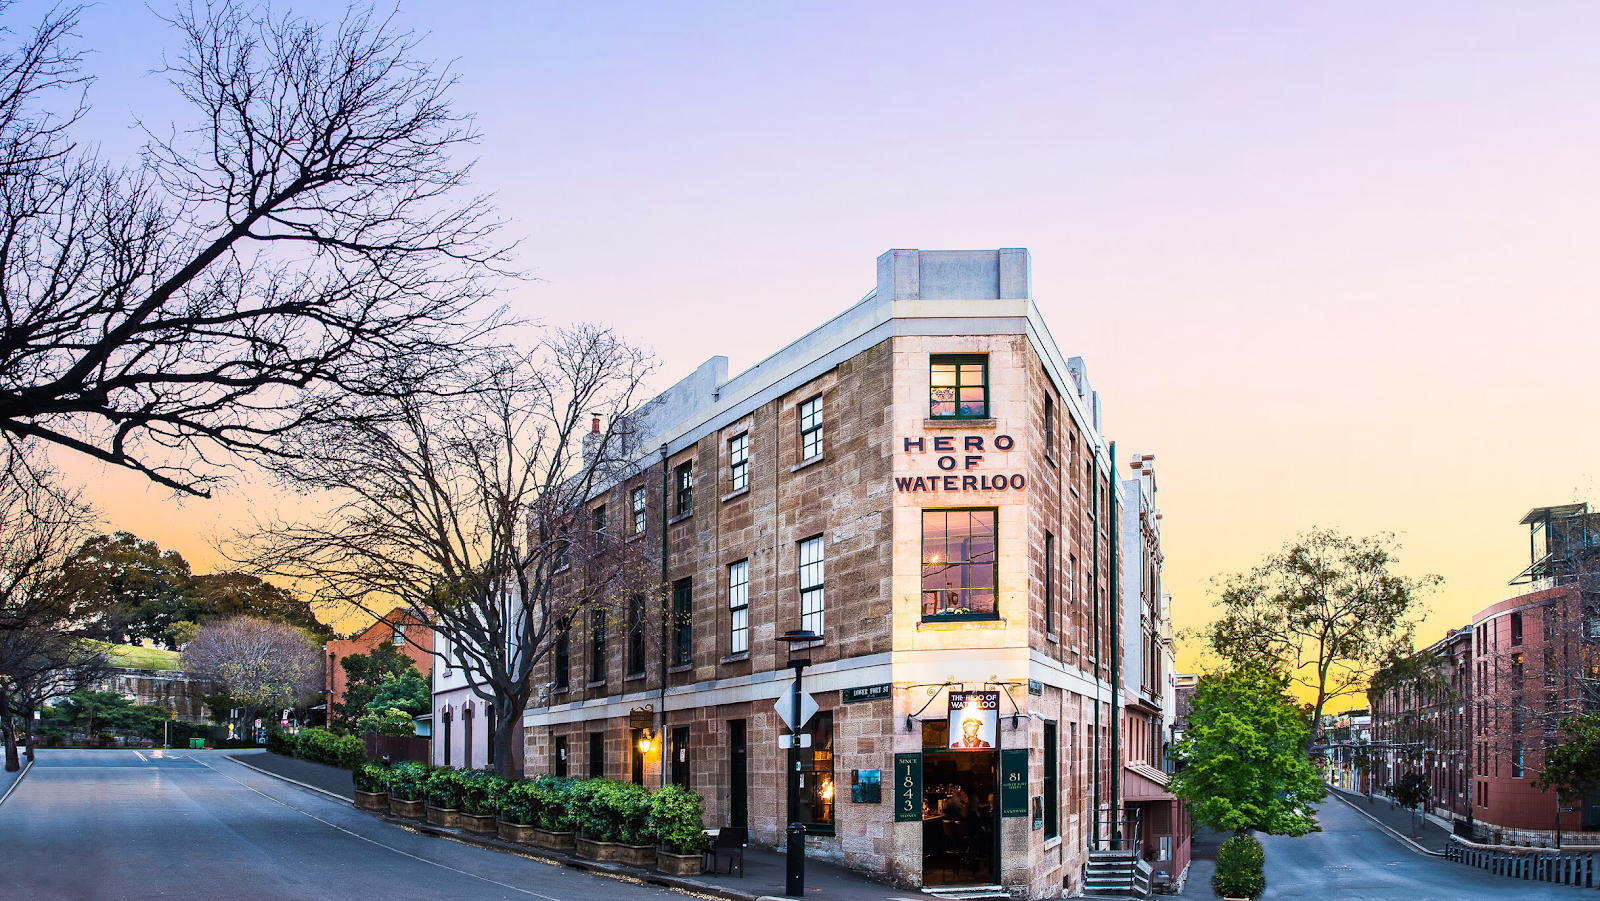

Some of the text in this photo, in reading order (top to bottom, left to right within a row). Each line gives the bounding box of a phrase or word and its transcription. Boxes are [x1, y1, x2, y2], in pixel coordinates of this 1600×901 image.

[904, 435, 1015, 454] HERO
[937, 456, 984, 472] OF
[895, 474, 1026, 493] WATERLOO
[853, 689, 868, 697] LOWER
[951, 701, 996, 709] WATLOO
[1009, 772, 1020, 782] 81
